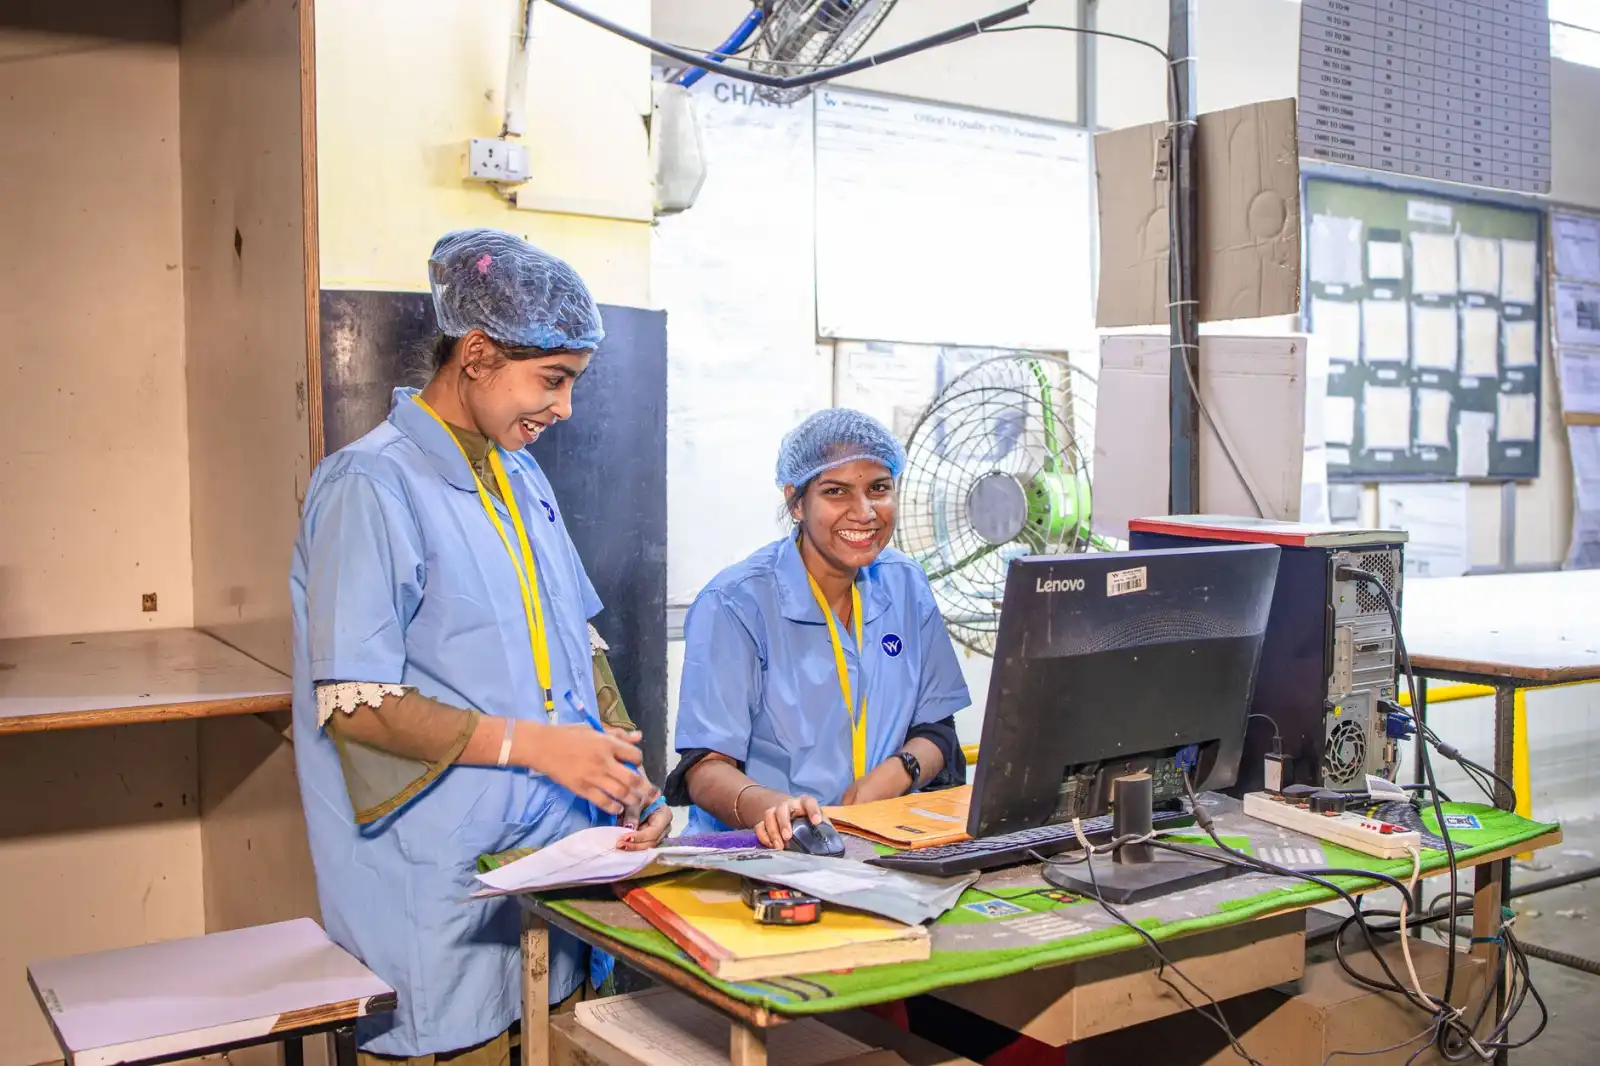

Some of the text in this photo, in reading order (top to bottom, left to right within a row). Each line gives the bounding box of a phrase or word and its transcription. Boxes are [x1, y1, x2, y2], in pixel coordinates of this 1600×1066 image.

[714, 82, 792, 108] CHA
[947, 117, 956, 127] To
[958, 118, 986, 132] Quality
[1036, 578, 1085, 593] Lenovo
